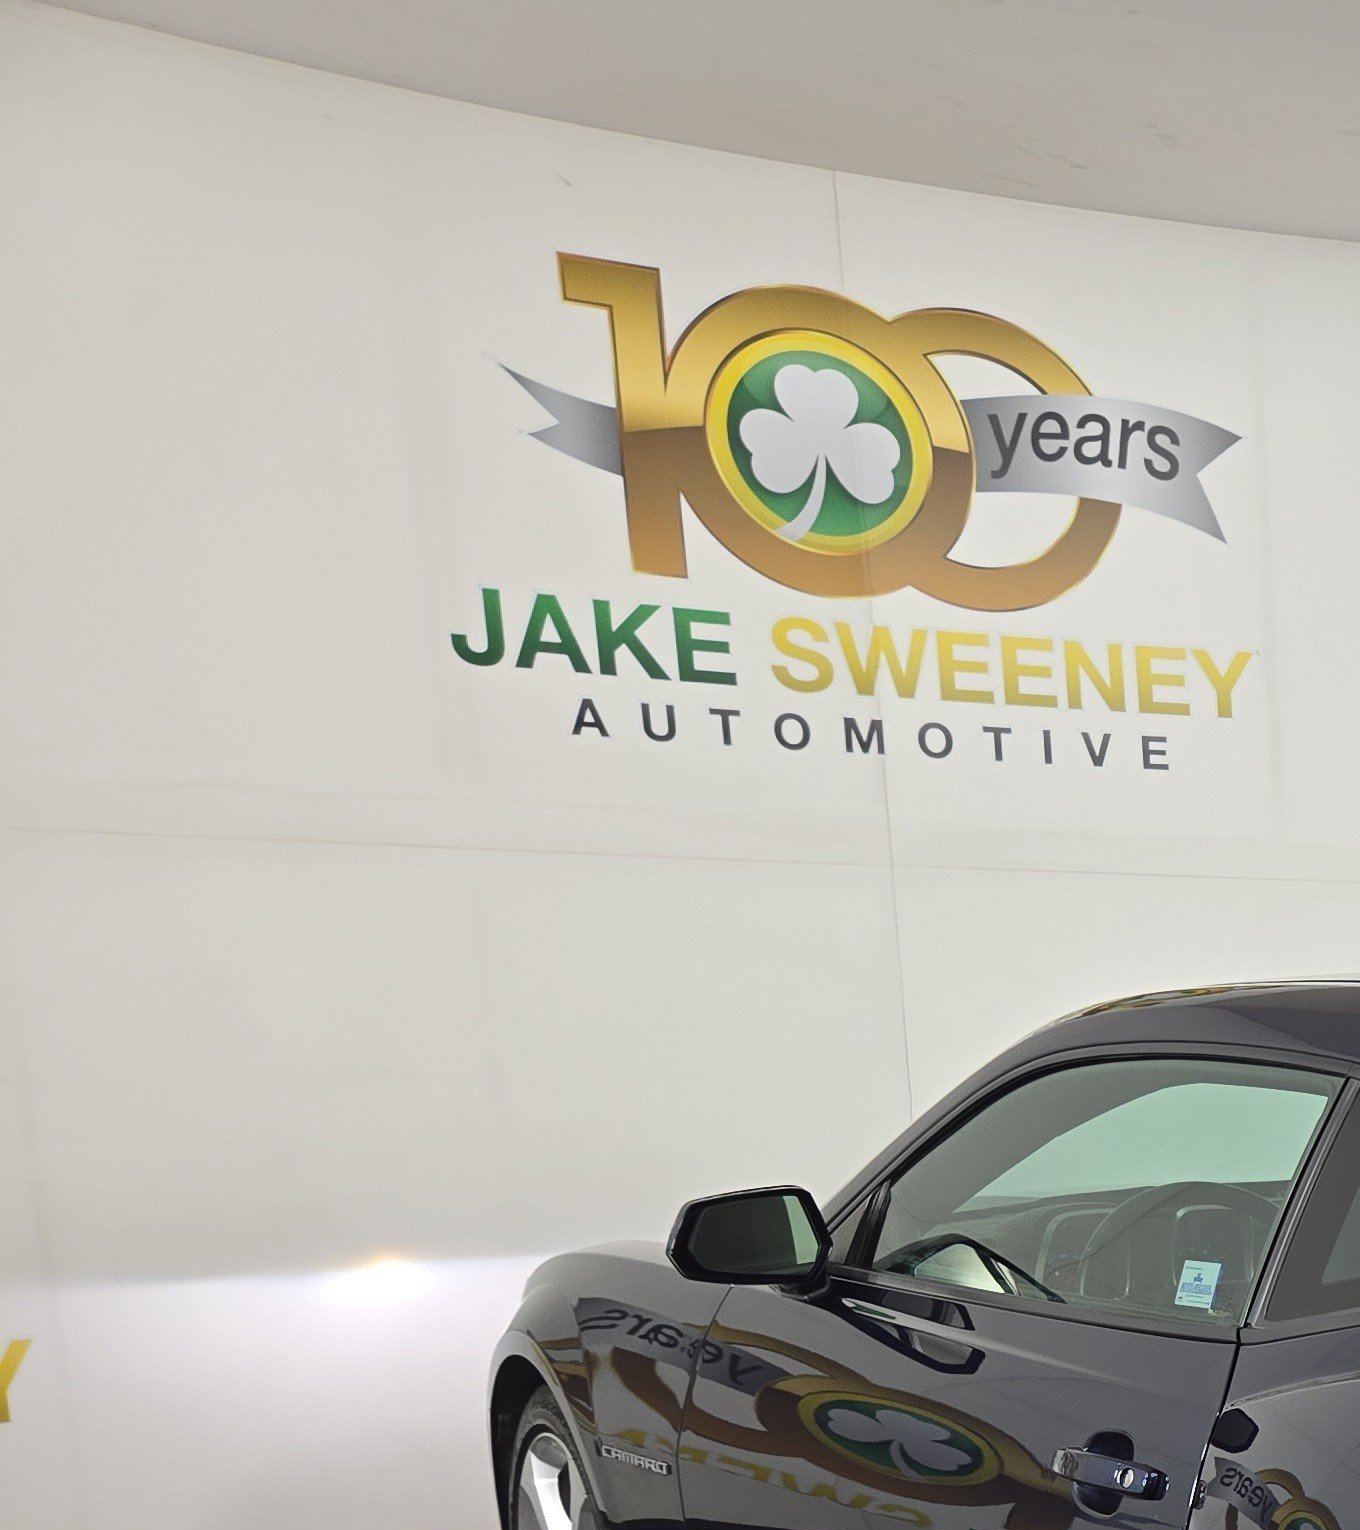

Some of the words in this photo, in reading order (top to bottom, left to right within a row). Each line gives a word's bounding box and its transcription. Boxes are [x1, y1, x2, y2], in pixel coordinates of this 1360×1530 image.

[986, 409, 1182, 481] years
[451, 587, 738, 685] JAKE
[771, 616, 1252, 719] SWEENEY
[573, 698, 1171, 771] AUTOMOTIVE
[601, 1445, 669, 1476] CAMARO
